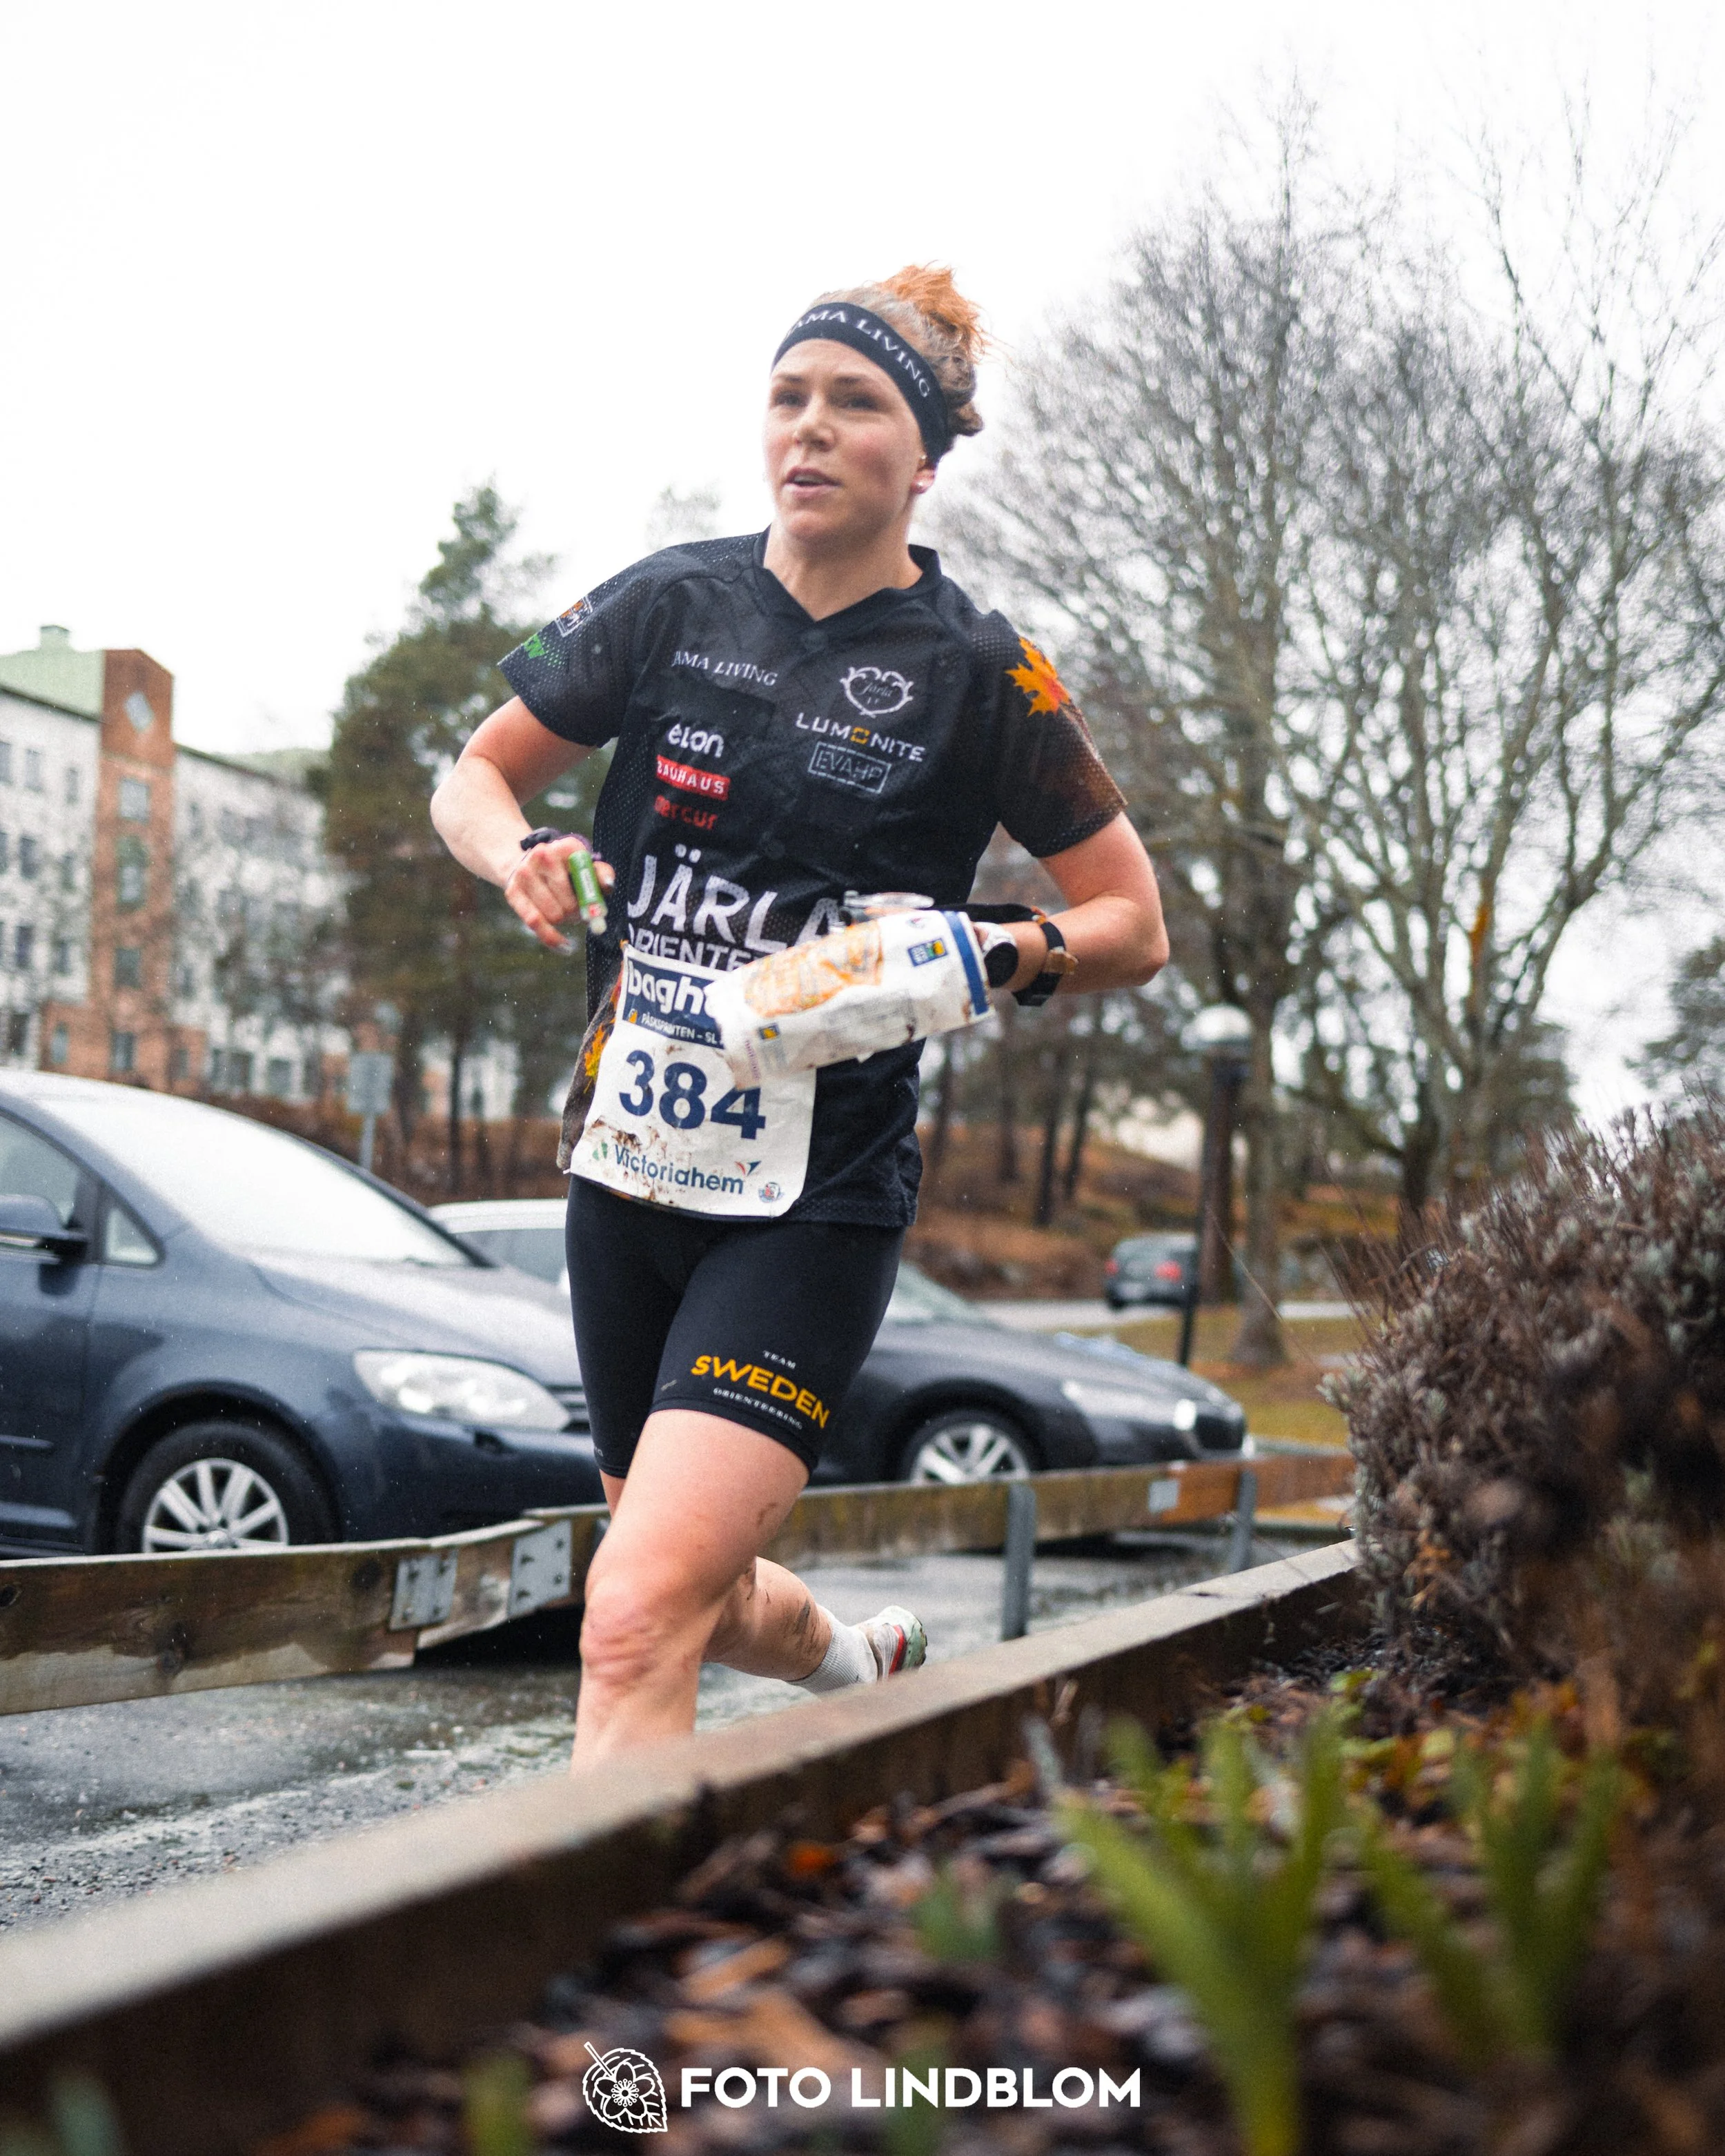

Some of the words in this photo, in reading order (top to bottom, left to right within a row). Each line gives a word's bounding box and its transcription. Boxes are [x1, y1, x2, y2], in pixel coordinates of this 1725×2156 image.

[856, 319, 930, 397] LIVING
[713, 661, 778, 686] LIVING
[796, 712, 926, 762] LUMONITE
[627, 843, 840, 954] JÄRLA
[619, 1050, 766, 1140] 384
[615, 1144, 744, 1194] Victoriahem
[762, 1350, 796, 1369] TEAM
[691, 1354, 830, 1429] SWEDEN
[713, 1387, 802, 1430] ORIENTERING
